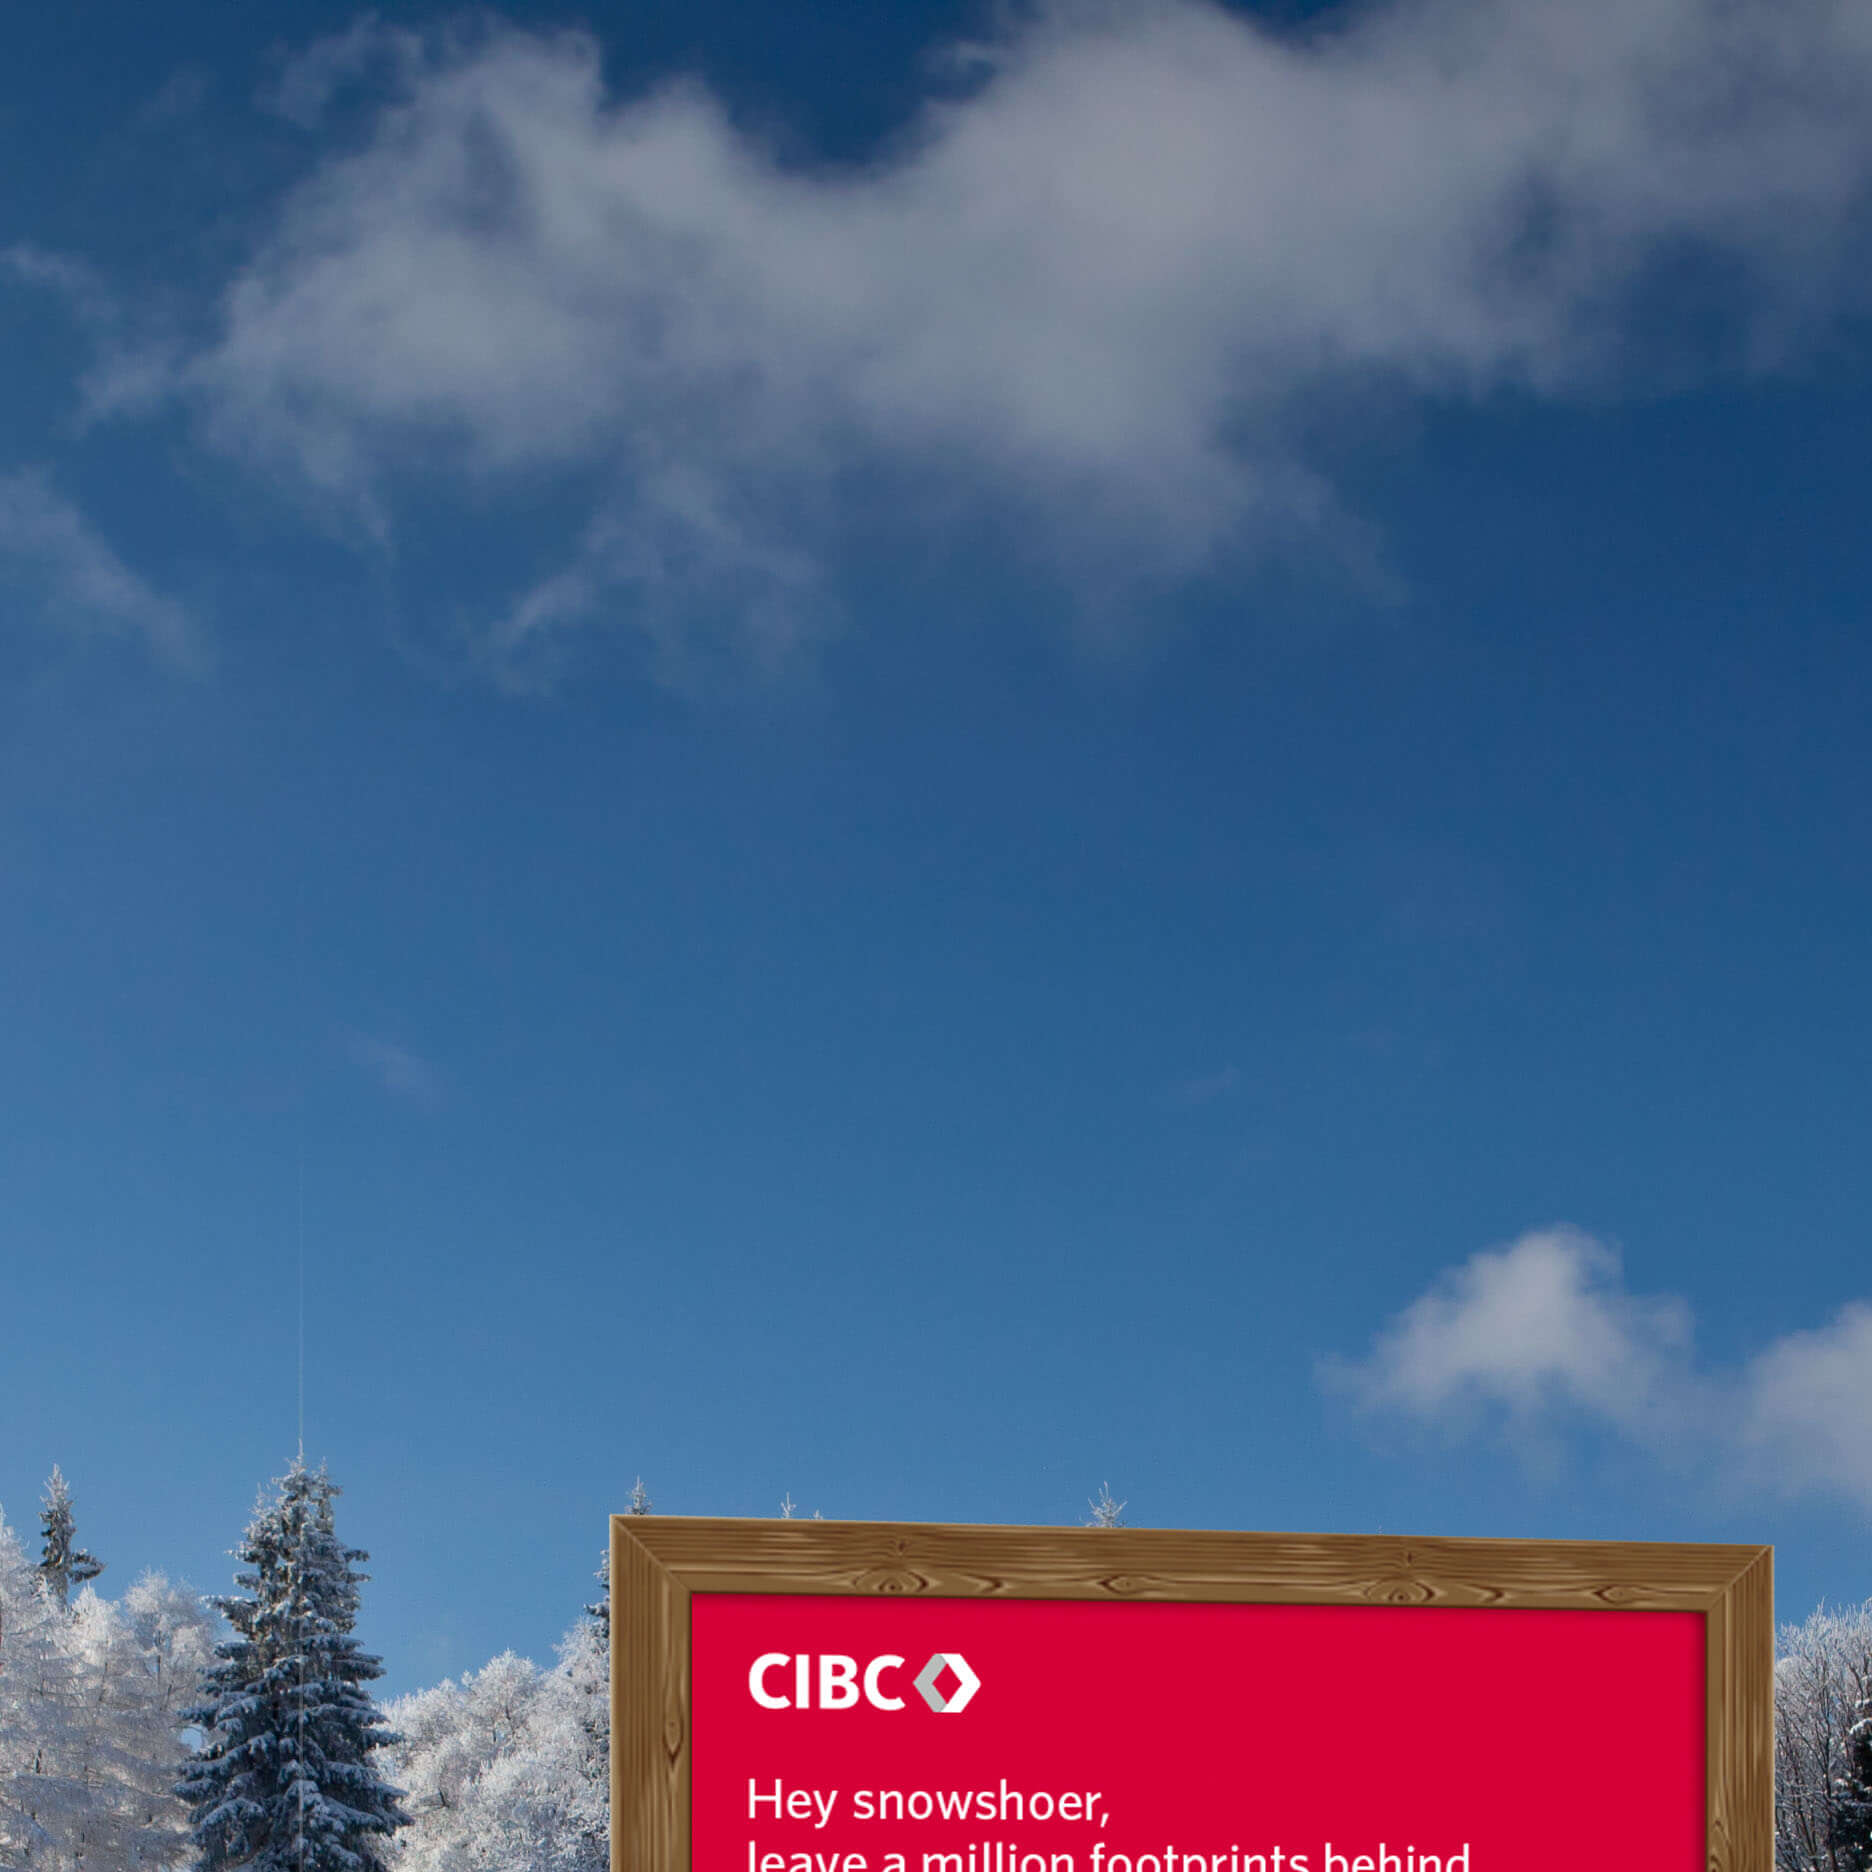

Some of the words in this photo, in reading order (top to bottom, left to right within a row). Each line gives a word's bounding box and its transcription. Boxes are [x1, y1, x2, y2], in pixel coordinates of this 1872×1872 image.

[748, 1652, 906, 1712] CIBC
[748, 1777, 839, 1829] Hey
[853, 1778, 1110, 1828] snowshoer,
